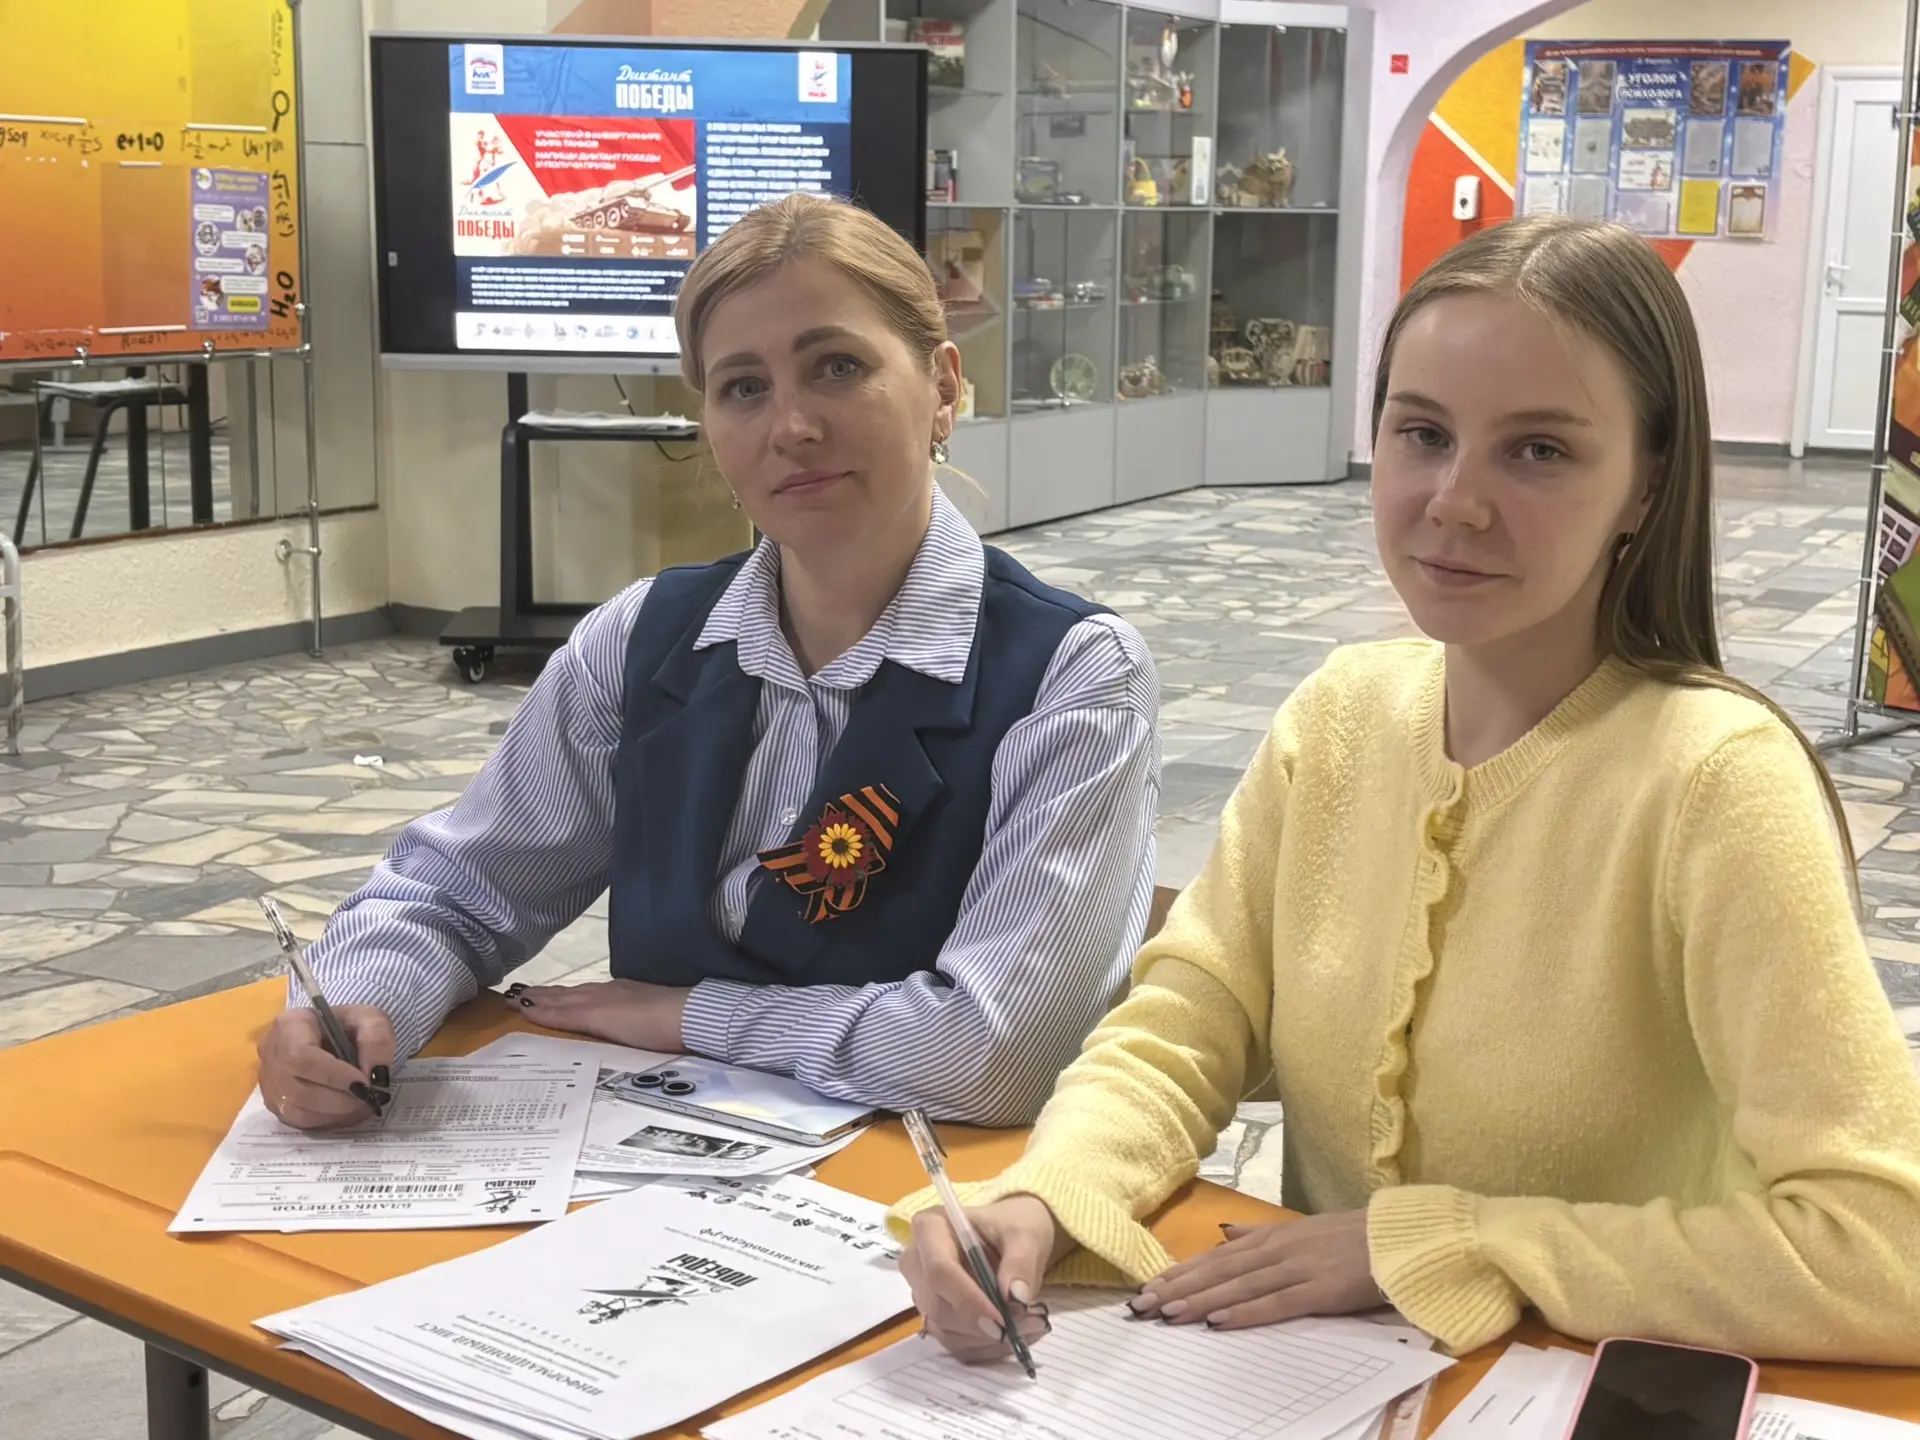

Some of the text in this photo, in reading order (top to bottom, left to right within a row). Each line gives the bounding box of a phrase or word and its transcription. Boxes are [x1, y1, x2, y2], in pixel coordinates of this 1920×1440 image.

[616, 64, 693, 83] Диктант
[616, 84, 694, 113] ПОБЕДЫ
[457, 219, 515, 240] ПОБЕДЫ
[273, 1203, 350, 1212] ОТВЕТОВ
[665, 1253, 760, 1287] ПОБЕДЫ
